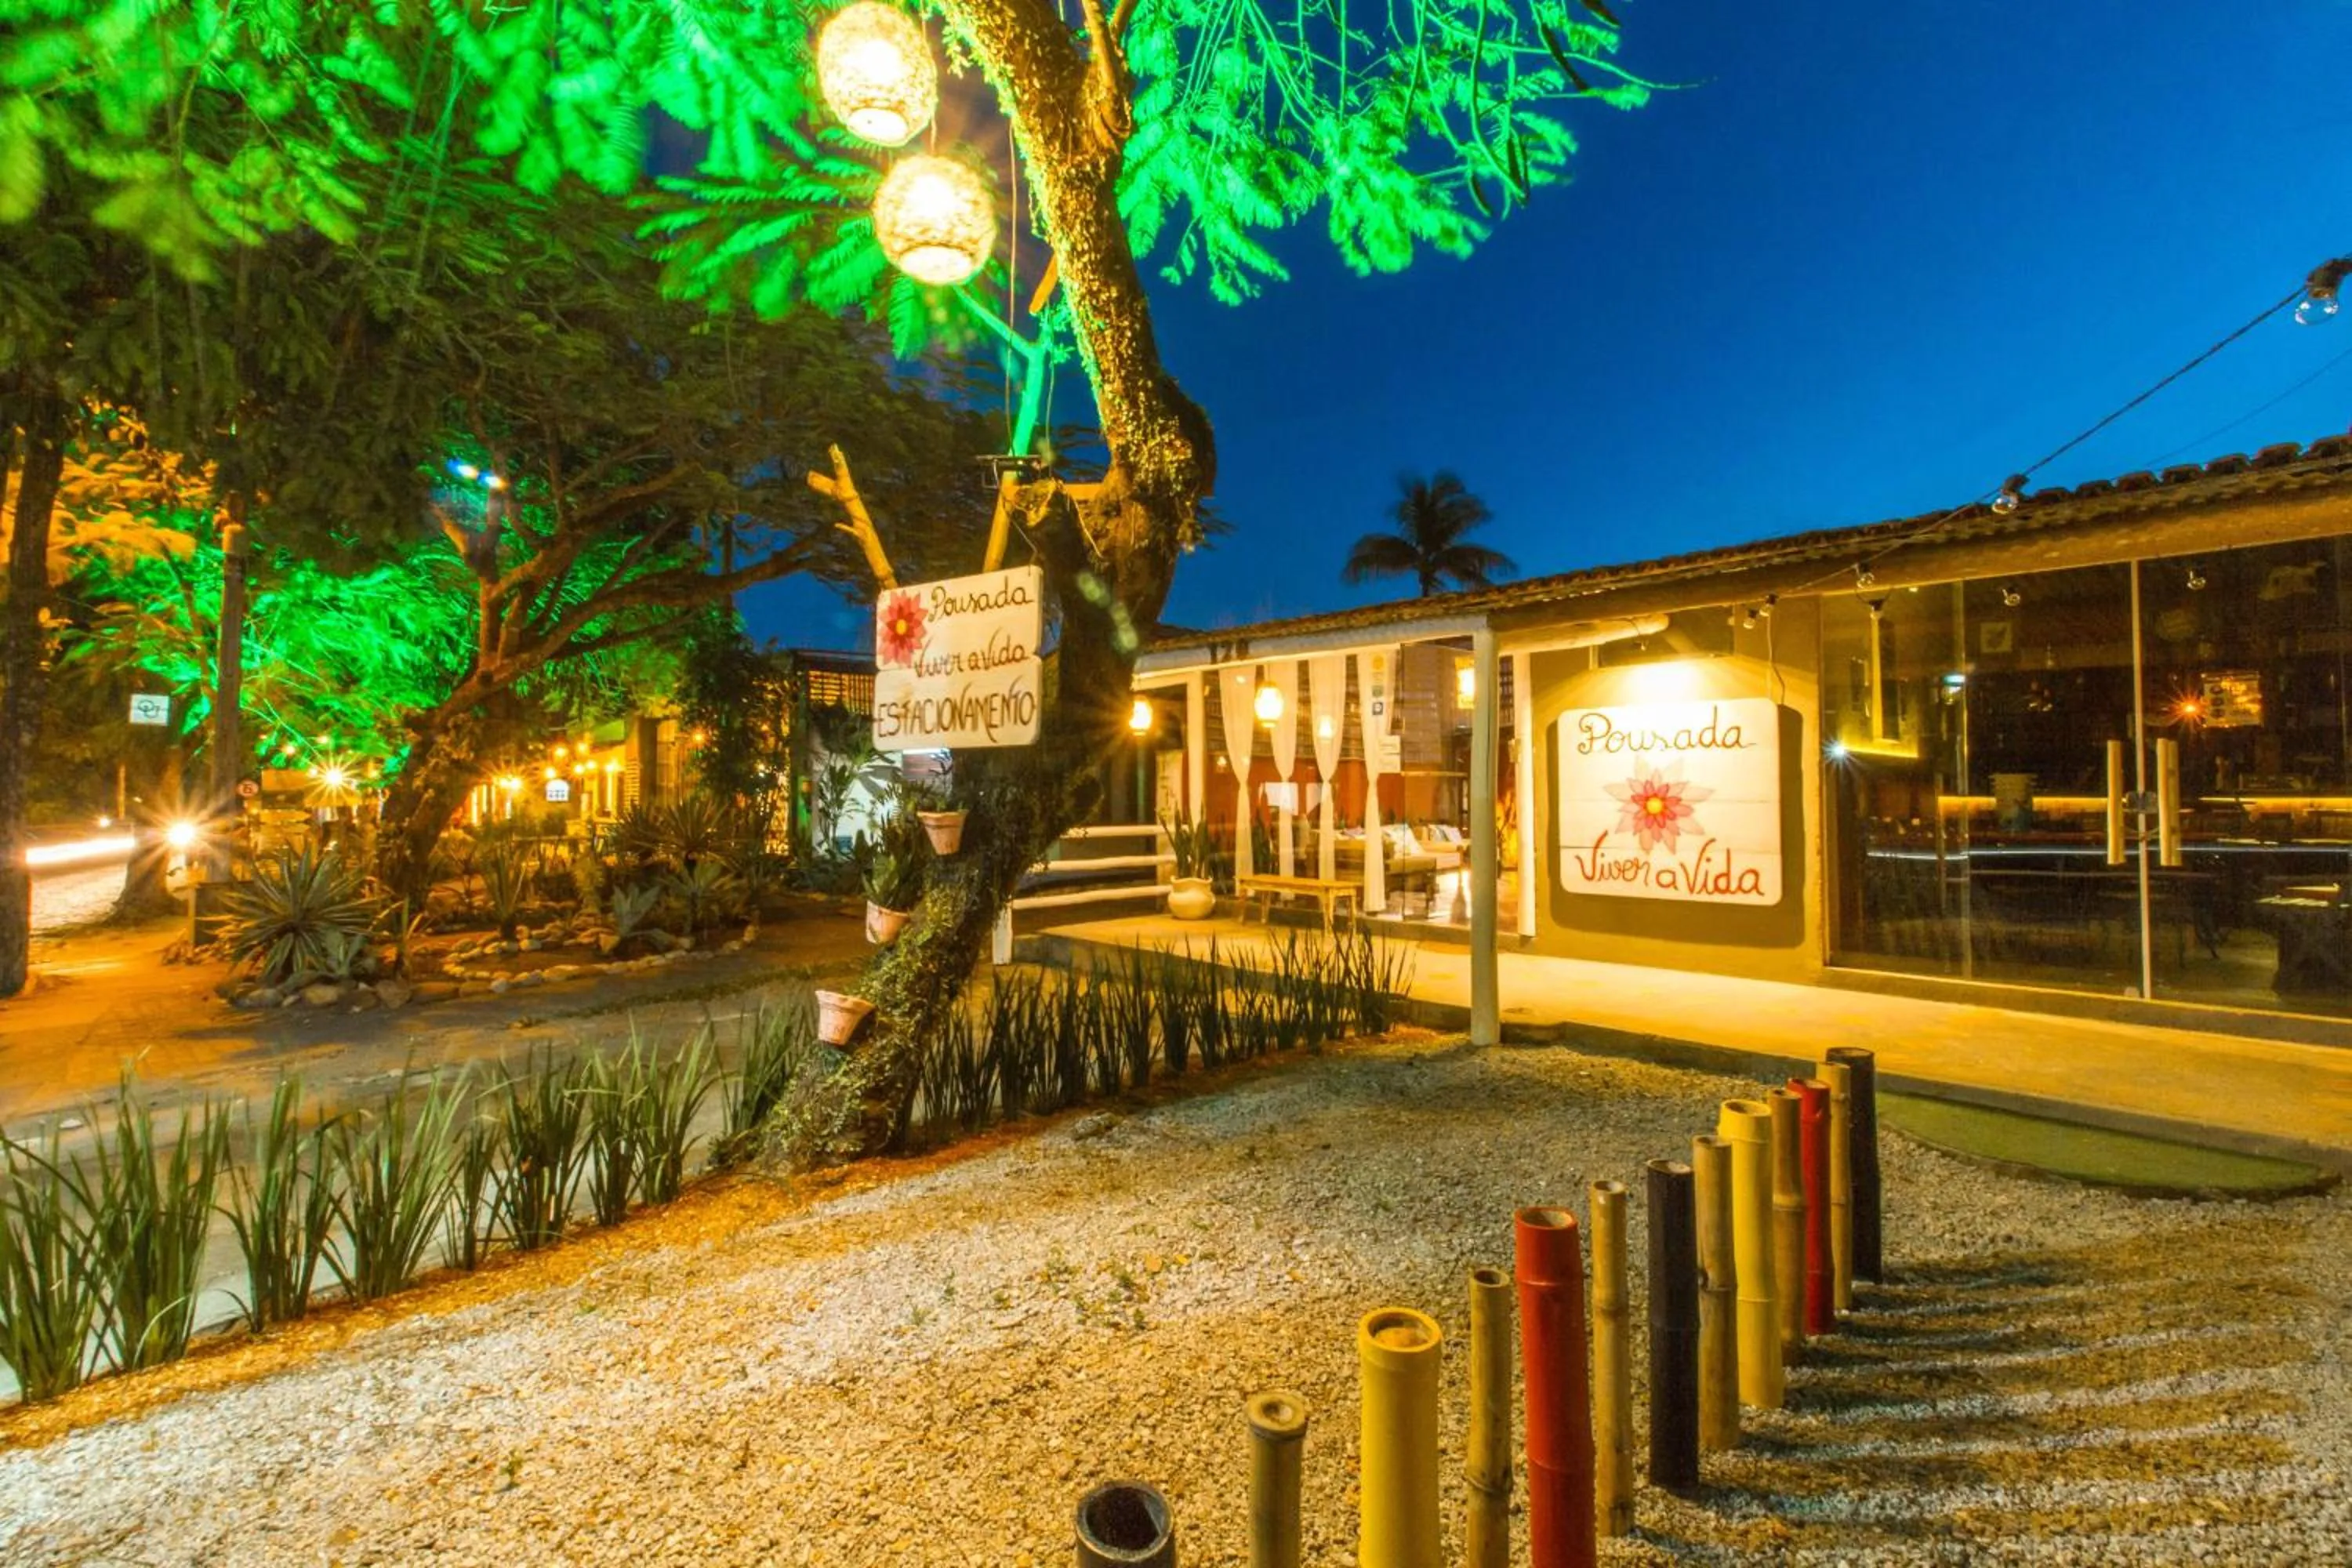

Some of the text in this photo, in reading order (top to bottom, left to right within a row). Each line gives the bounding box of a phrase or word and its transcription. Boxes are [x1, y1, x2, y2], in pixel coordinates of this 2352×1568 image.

[927, 575, 1034, 622] Pousada
[967, 653, 981, 670] a
[979, 626, 1029, 670] Vida
[876, 675, 1036, 743] ESTACIONAMENTO
[1577, 705, 1757, 755] Pousada
[1574, 829, 1765, 896] Viver a Vida
